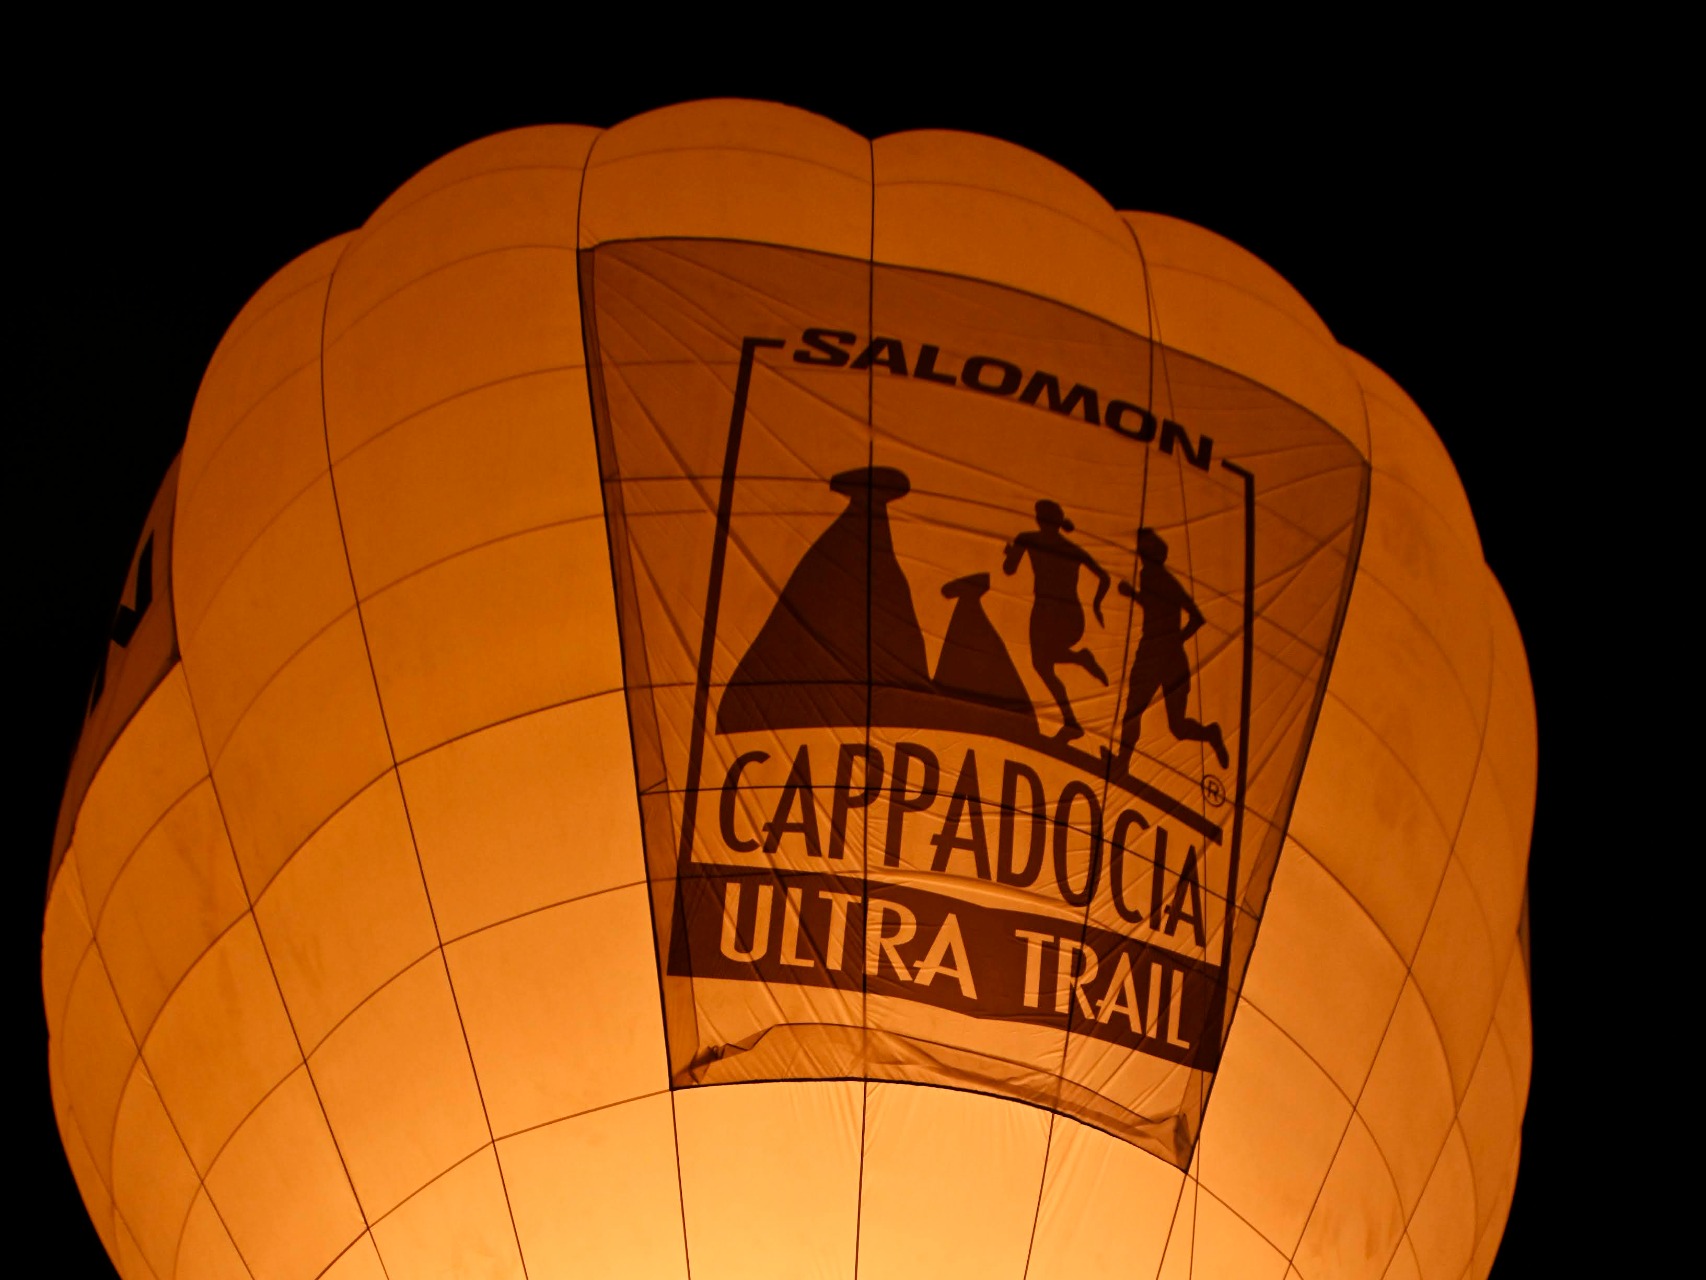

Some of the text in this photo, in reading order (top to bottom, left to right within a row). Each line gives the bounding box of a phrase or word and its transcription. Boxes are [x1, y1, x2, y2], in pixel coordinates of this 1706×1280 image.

[793, 328, 1213, 472] SALOMON
[718, 742, 1207, 948] CAPPADOCIA
[720, 882, 1190, 1050] ULTRA TRAIL
